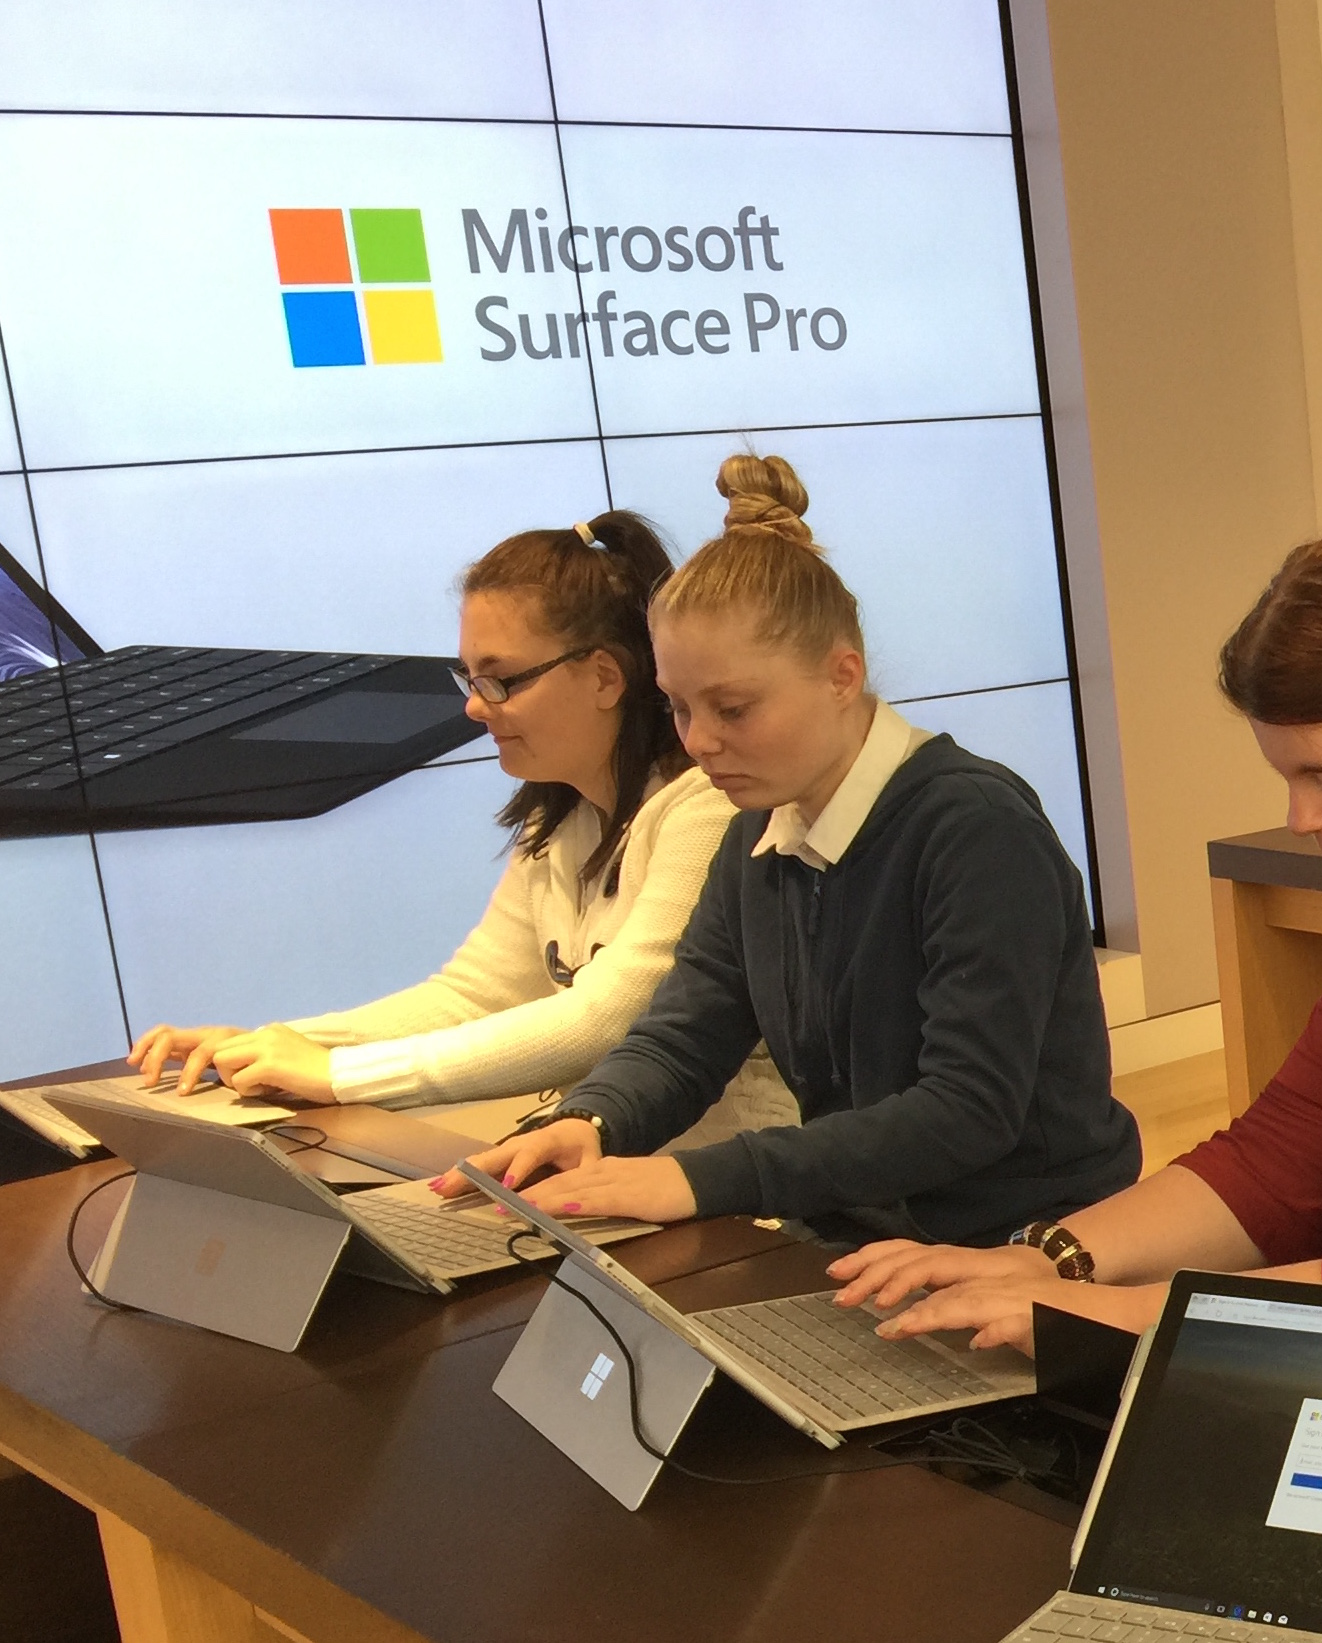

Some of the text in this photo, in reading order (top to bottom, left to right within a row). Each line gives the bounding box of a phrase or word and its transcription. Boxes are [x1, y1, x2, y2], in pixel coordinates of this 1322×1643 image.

[461, 205, 784, 274] Microsoft
[474, 290, 848, 362] Surface Pro
